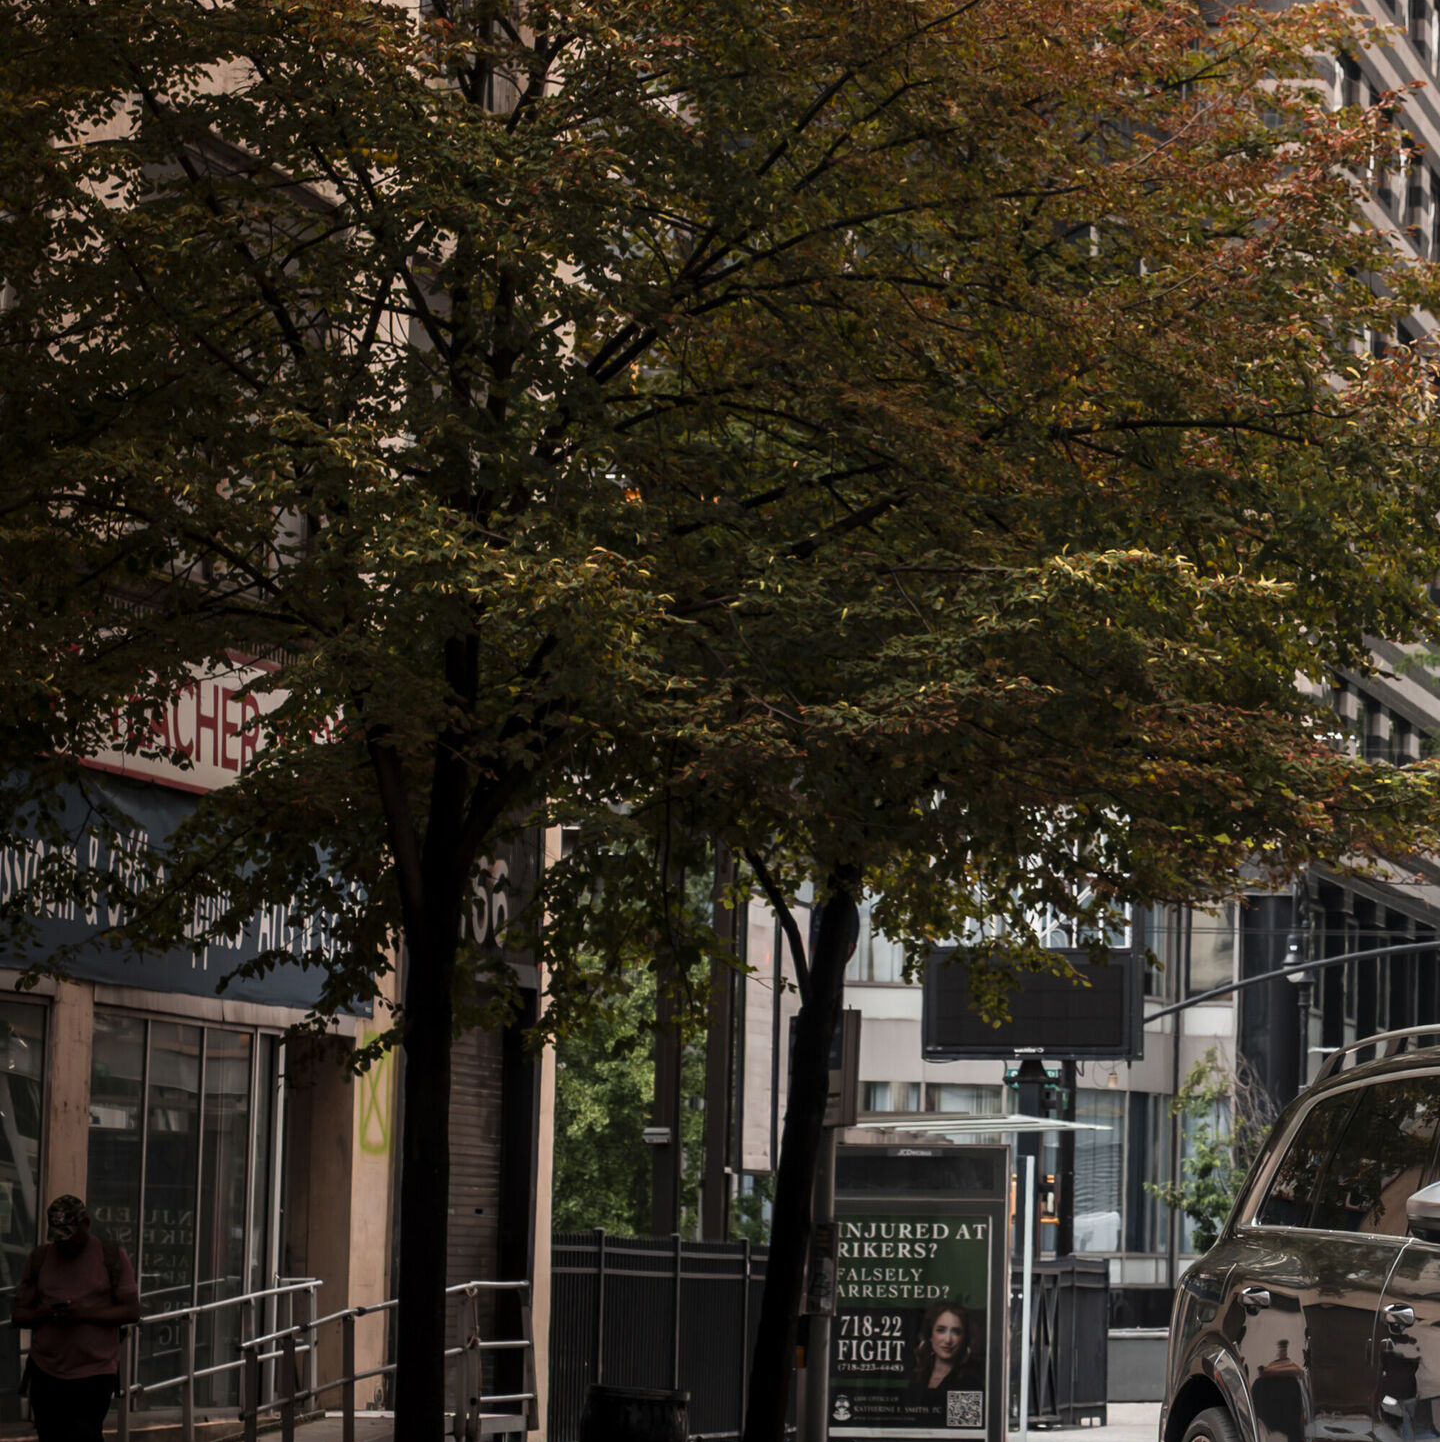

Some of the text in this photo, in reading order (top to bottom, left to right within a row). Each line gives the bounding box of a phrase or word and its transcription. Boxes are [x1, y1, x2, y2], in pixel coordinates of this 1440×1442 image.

[837, 1222, 987, 1240] INJURED AT
[837, 1242, 938, 1258] RIKERS?
[836, 1268, 923, 1282] FALSELY
[836, 1285, 950, 1299] ARRESTED?
[840, 1315, 902, 1337] 718-22
[837, 1339, 905, 1361] FIGHT
